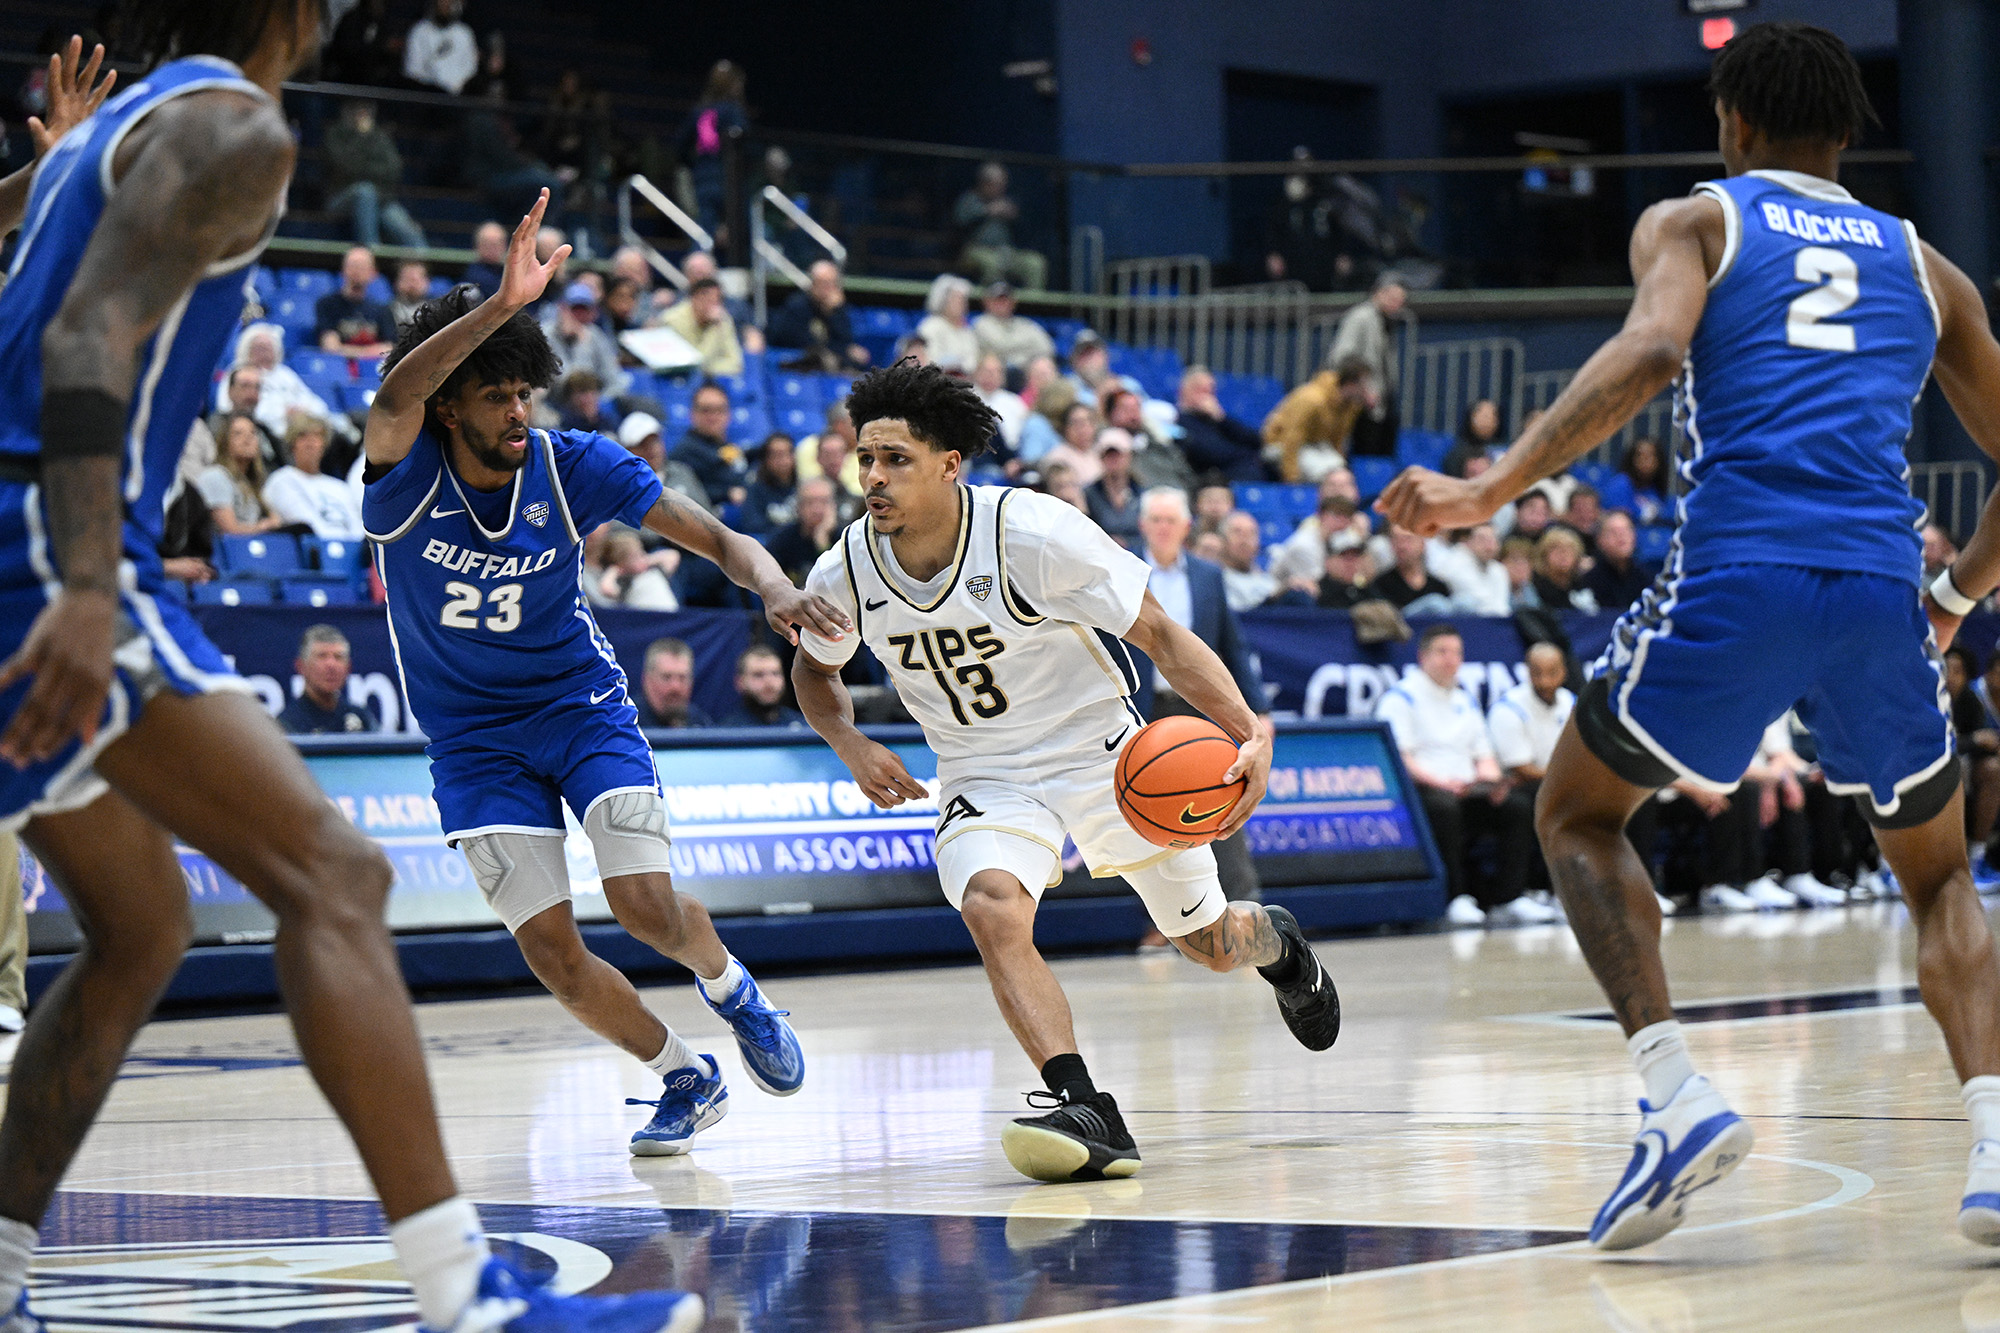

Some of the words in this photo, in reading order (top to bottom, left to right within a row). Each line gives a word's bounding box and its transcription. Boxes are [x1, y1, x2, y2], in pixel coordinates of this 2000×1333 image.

[1761, 202, 1884, 249] BLOCKER
[1786, 246, 1860, 352] 2
[526, 507, 549, 521] MAC
[421, 538, 557, 579] BUFFALO
[440, 580, 524, 633] 23
[968, 581, 992, 593] MAC
[886, 622, 1007, 671] ZIPS
[933, 662, 1010, 726] 13
